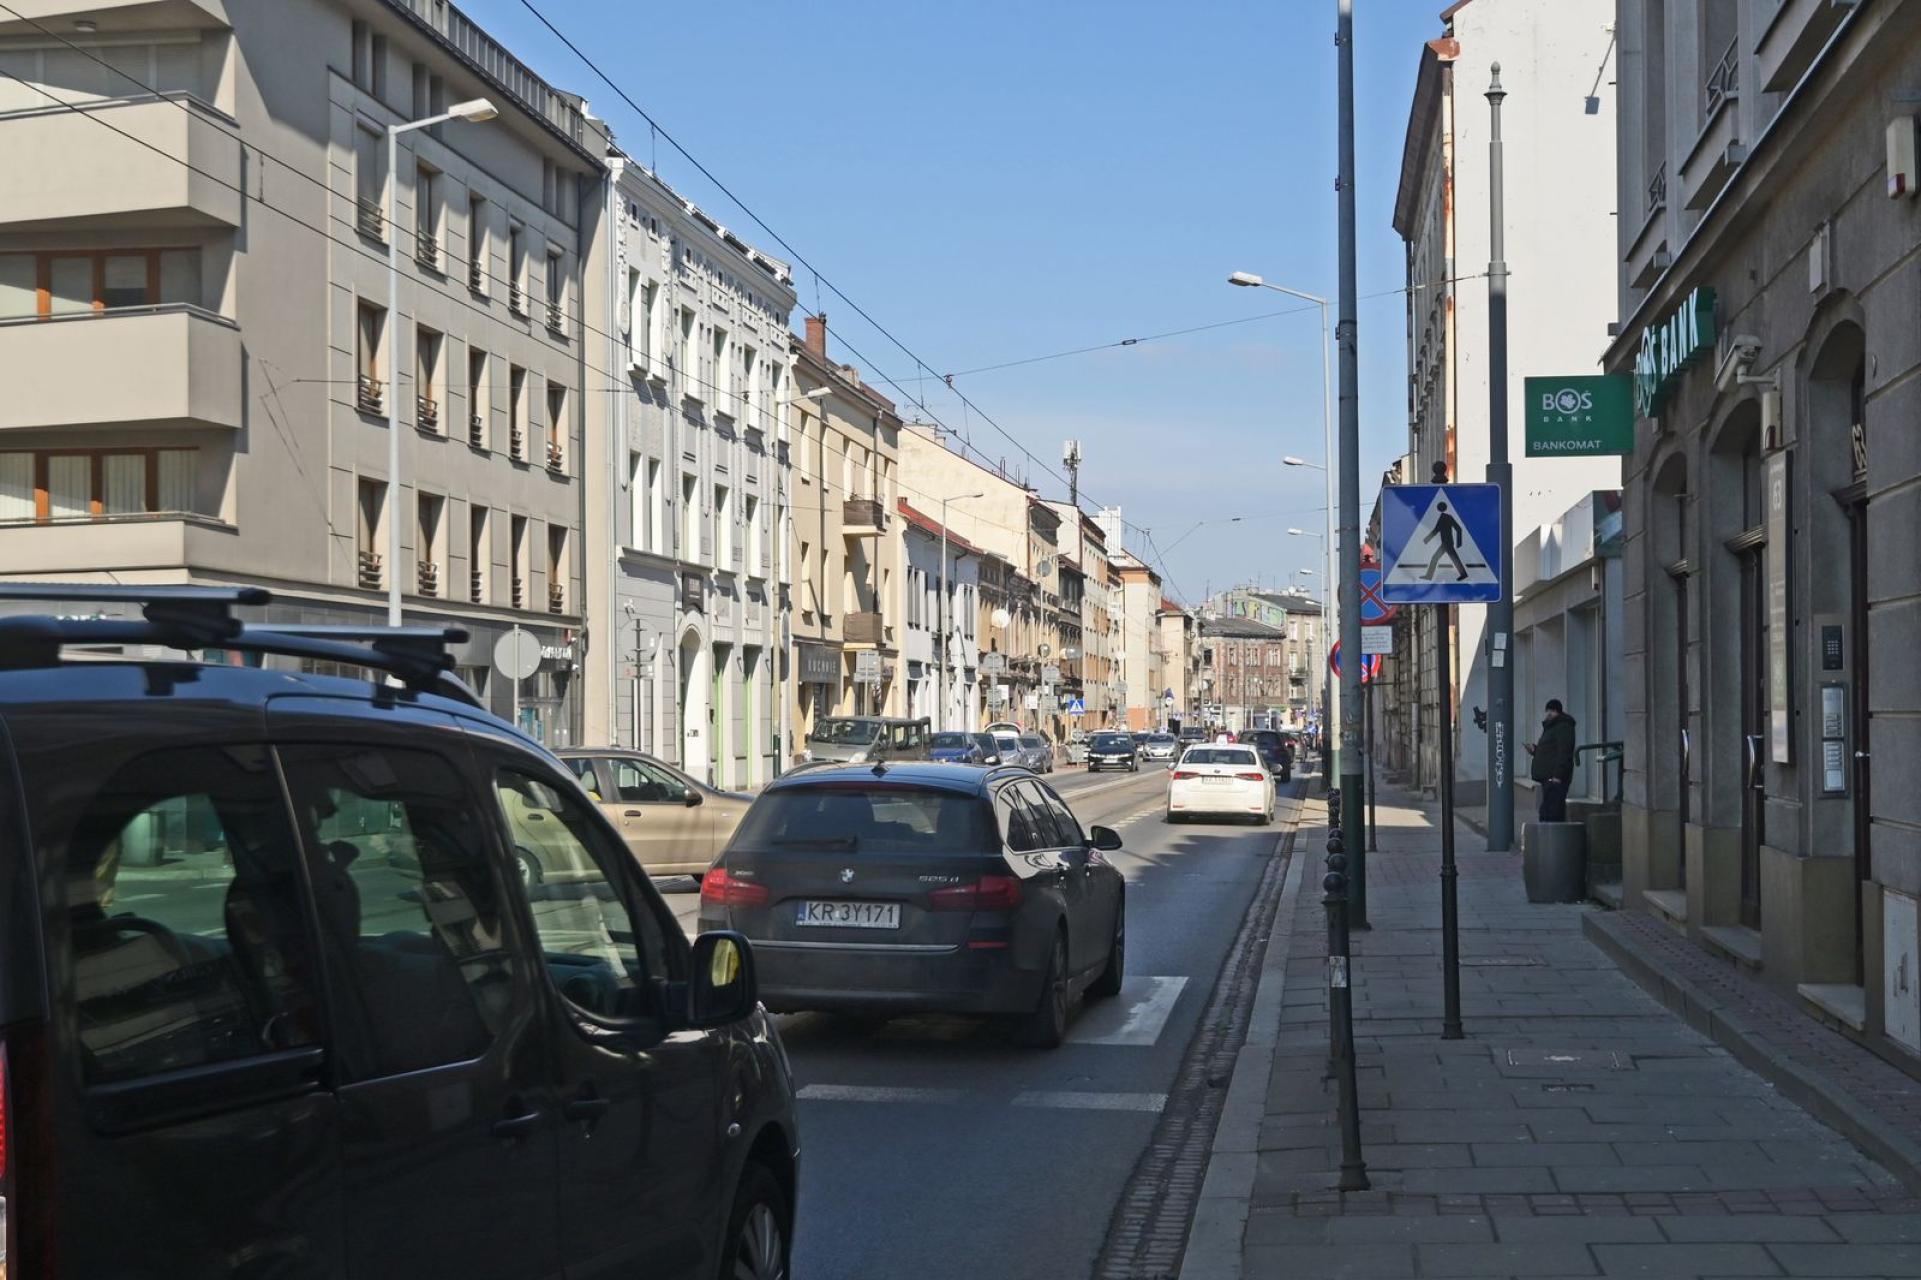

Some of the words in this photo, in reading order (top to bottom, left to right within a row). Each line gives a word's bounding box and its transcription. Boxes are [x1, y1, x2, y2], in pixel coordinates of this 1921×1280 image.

[1661, 287, 1699, 381] BANK
[1542, 388, 1593, 414] BOŚ
[1543, 415, 1592, 423] BANK
[1533, 440, 1602, 450] BANKOMAT
[808, 902, 833, 921] KR
[840, 903, 894, 925] 3Y171
